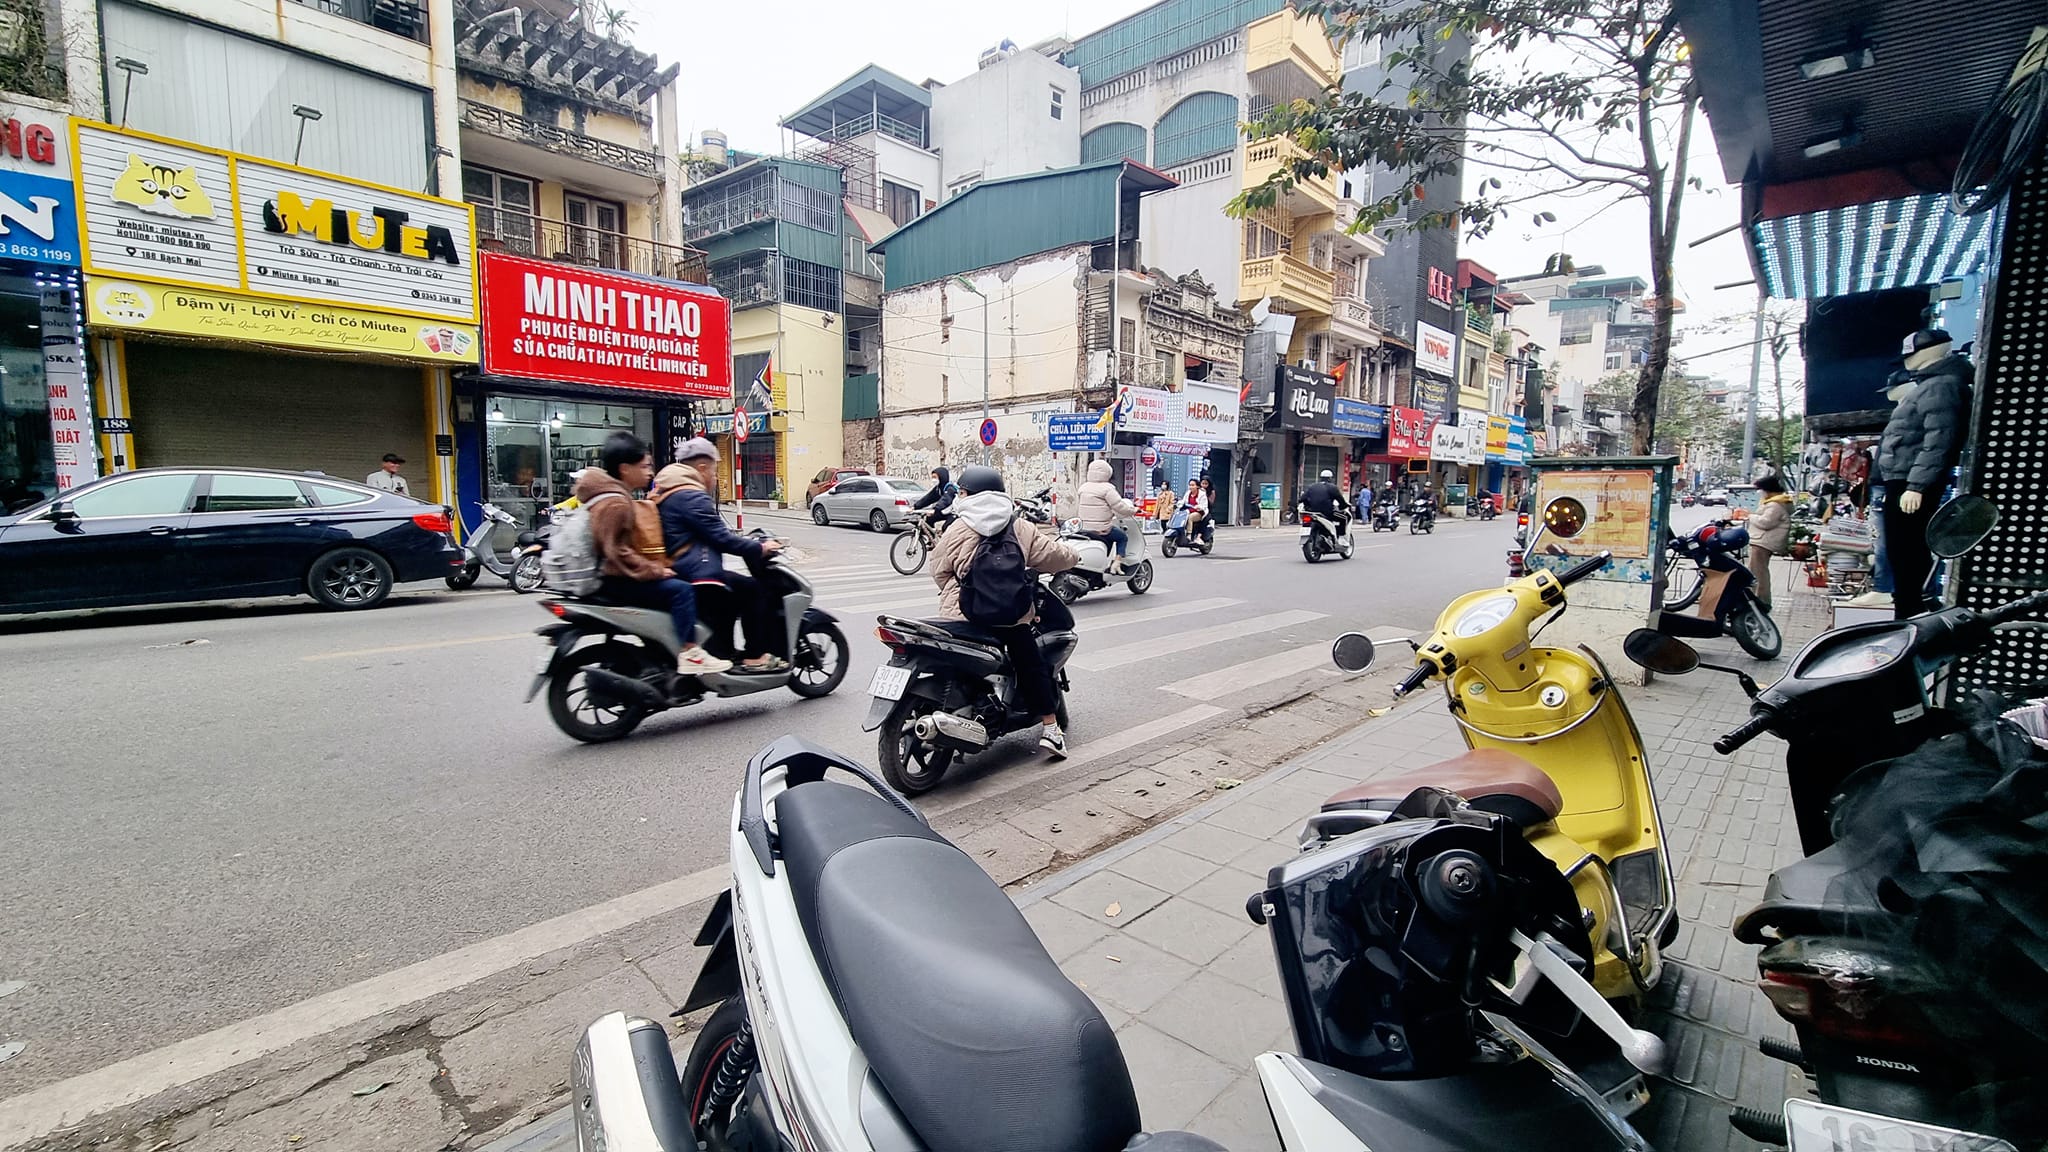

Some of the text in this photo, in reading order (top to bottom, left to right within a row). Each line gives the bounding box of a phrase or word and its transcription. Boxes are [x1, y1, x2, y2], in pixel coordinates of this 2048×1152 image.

[11, 244, 38, 256] 863
[42, 248, 72, 260] 1199
[160, 254, 182, 264] Bạch
[186, 258, 202, 267] Mai
[279, 245, 296, 256] Trà
[300, 249, 320, 260] Sữa
[330, 254, 346, 264] Trà
[350, 258, 381, 270] Chanh
[388, 264, 402, 272] Trà
[406, 266, 422, 276] Trái
[426, 270, 443, 280] Cây
[272, 270, 340, 287] Miutea Bạch Mai
[524, 272, 617, 327] MINH
[176, 296, 214, 310] Đậm
[219, 302, 235, 314] Vị
[252, 306, 275, 318] Lợi
[280, 308, 296, 320] Ví
[311, 314, 335, 325] Chỉ
[340, 317, 357, 328] Có
[362, 319, 407, 334] Miutea
[520, 318, 550, 340] PHỤ
[588, 326, 620, 348] ĐIỆN
[622, 333, 662, 354] THOẠI
[662, 338, 684, 355] GIÁ
[684, 340, 700, 358] RẺ
[513, 334, 708, 379] SỬA CHỮA THAY THẾ LINH KIỆN
[1188, 401, 1218, 420] HERO
[1290, 388, 1314, 418] Hà
[1309, 391, 1329, 414] Lan
[104, 420, 128, 429] 188
[1050, 422, 1068, 434] CHÙA
[1070, 422, 1086, 434] LIÊN
[1856, 1054, 1920, 1074] HONDA
